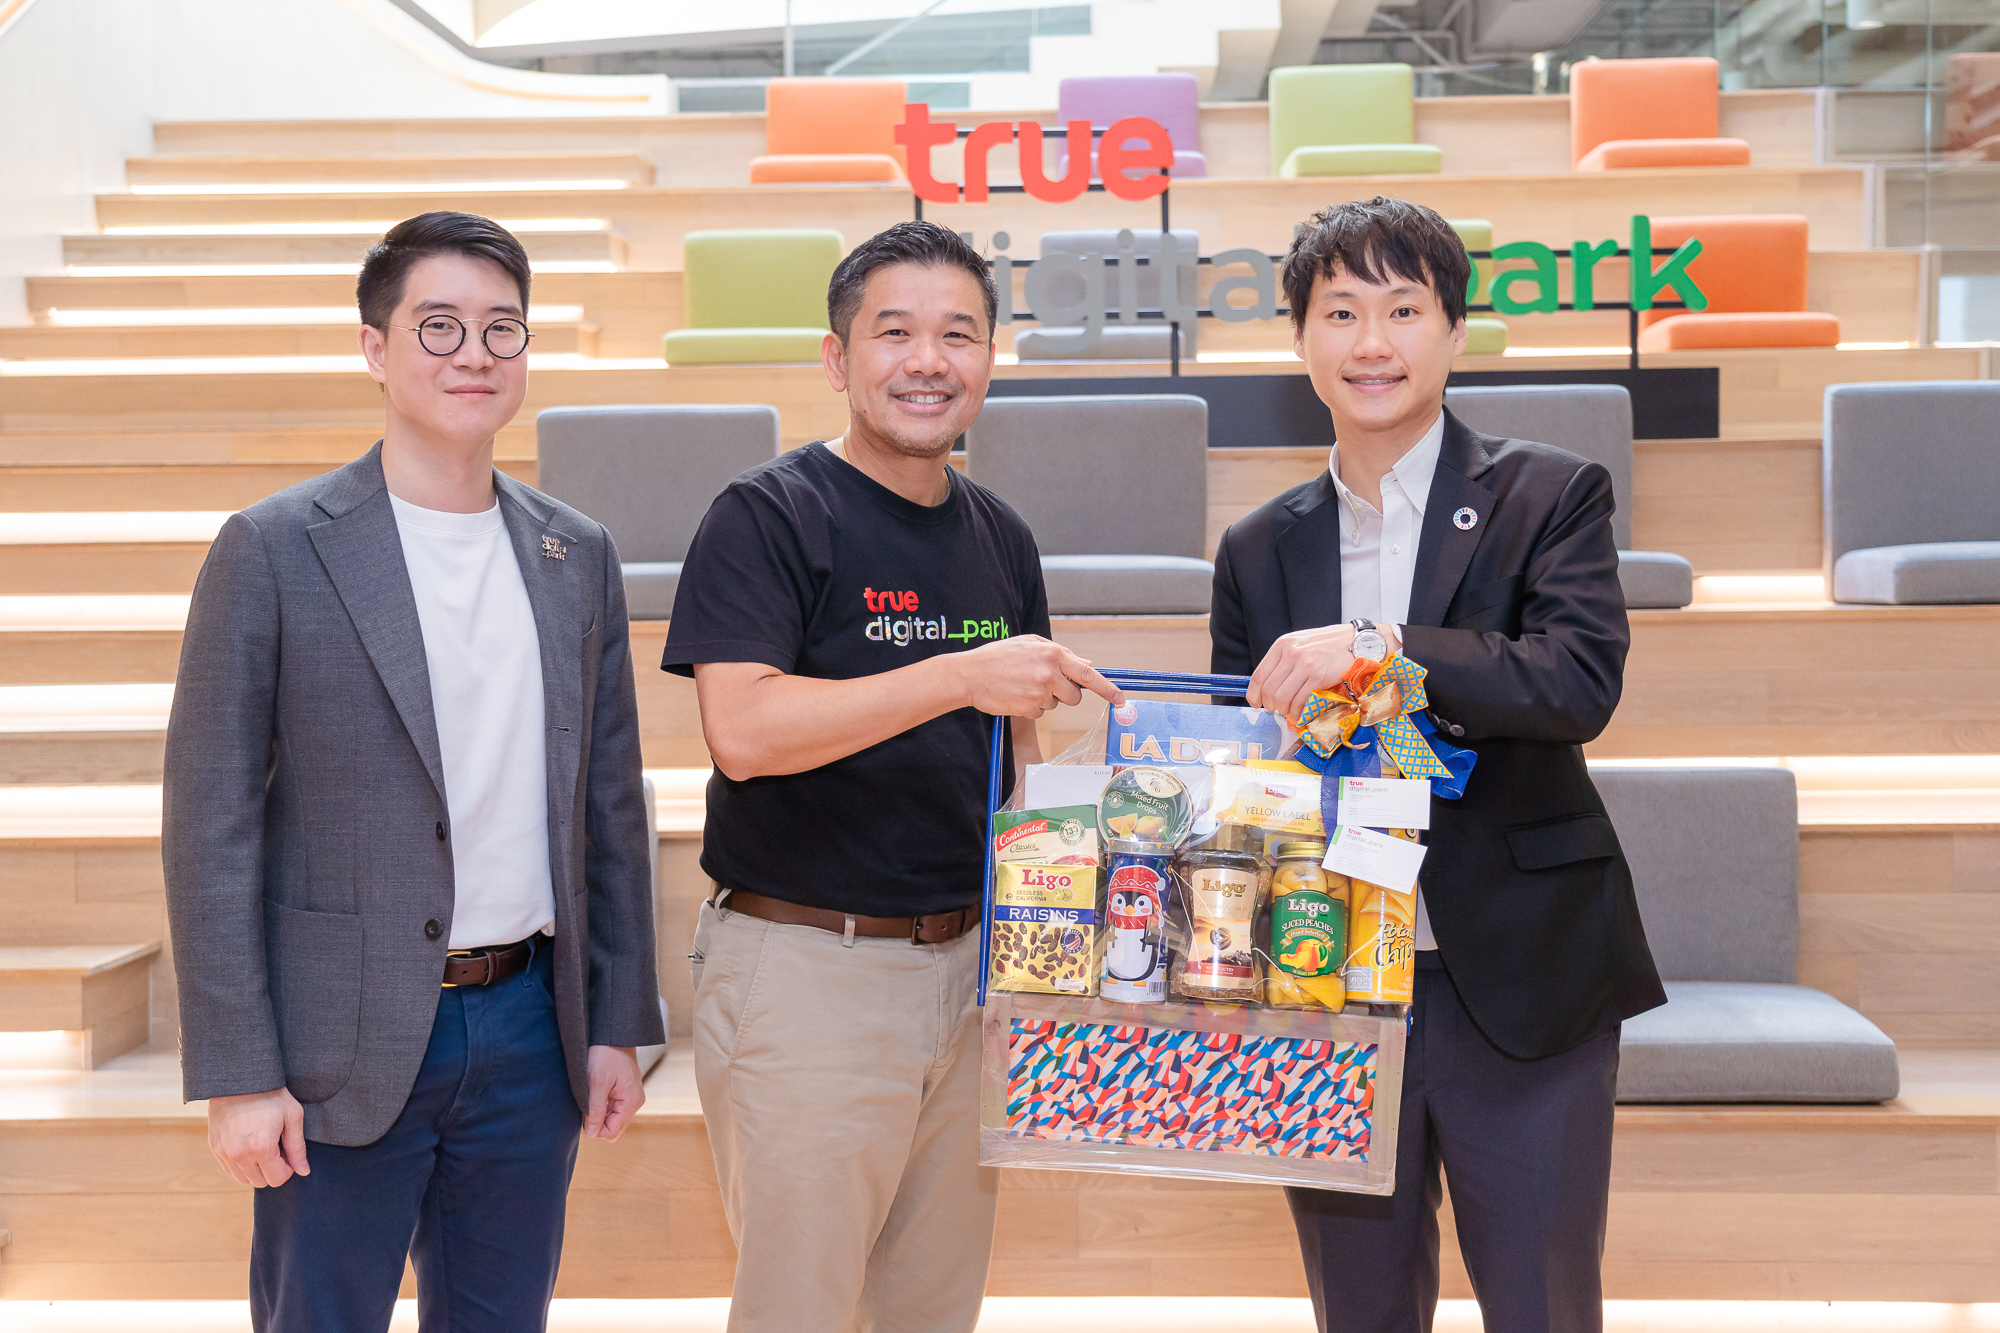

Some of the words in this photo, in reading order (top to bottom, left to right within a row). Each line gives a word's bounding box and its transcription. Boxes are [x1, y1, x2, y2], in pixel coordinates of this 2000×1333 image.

[895, 103, 1175, 204] true
[961, 225, 1302, 354] igita
[1466, 215, 1708, 315] ark
[863, 587, 919, 613] true
[1117, 707, 1135, 716] DELI
[1120, 733, 1169, 763] LA
[1130, 790, 1152, 805] Mixed
[1152, 798, 1169, 811] Fruit
[1268, 786, 1294, 796] Lipton
[1136, 801, 1157, 815] Drops
[1245, 806, 1281, 817] YELLOW
[1283, 810, 1311, 821] LABEL
[999, 821, 1047, 847] Continental
[1348, 828, 1362, 836] true
[1009, 843, 1036, 854] Classics
[1021, 868, 1072, 891] Ligo
[1202, 878, 1247, 898] Ligo
[1009, 907, 1079, 922] RAISINS
[1287, 899, 1330, 918] Ligo
[1282, 919, 1305, 932] SLICED
[1305, 919, 1334, 935] PEACHES
[1305, 929, 1325, 939] Selected
[1378, 921, 1414, 941] Potat
[1369, 938, 1414, 972] Chip
